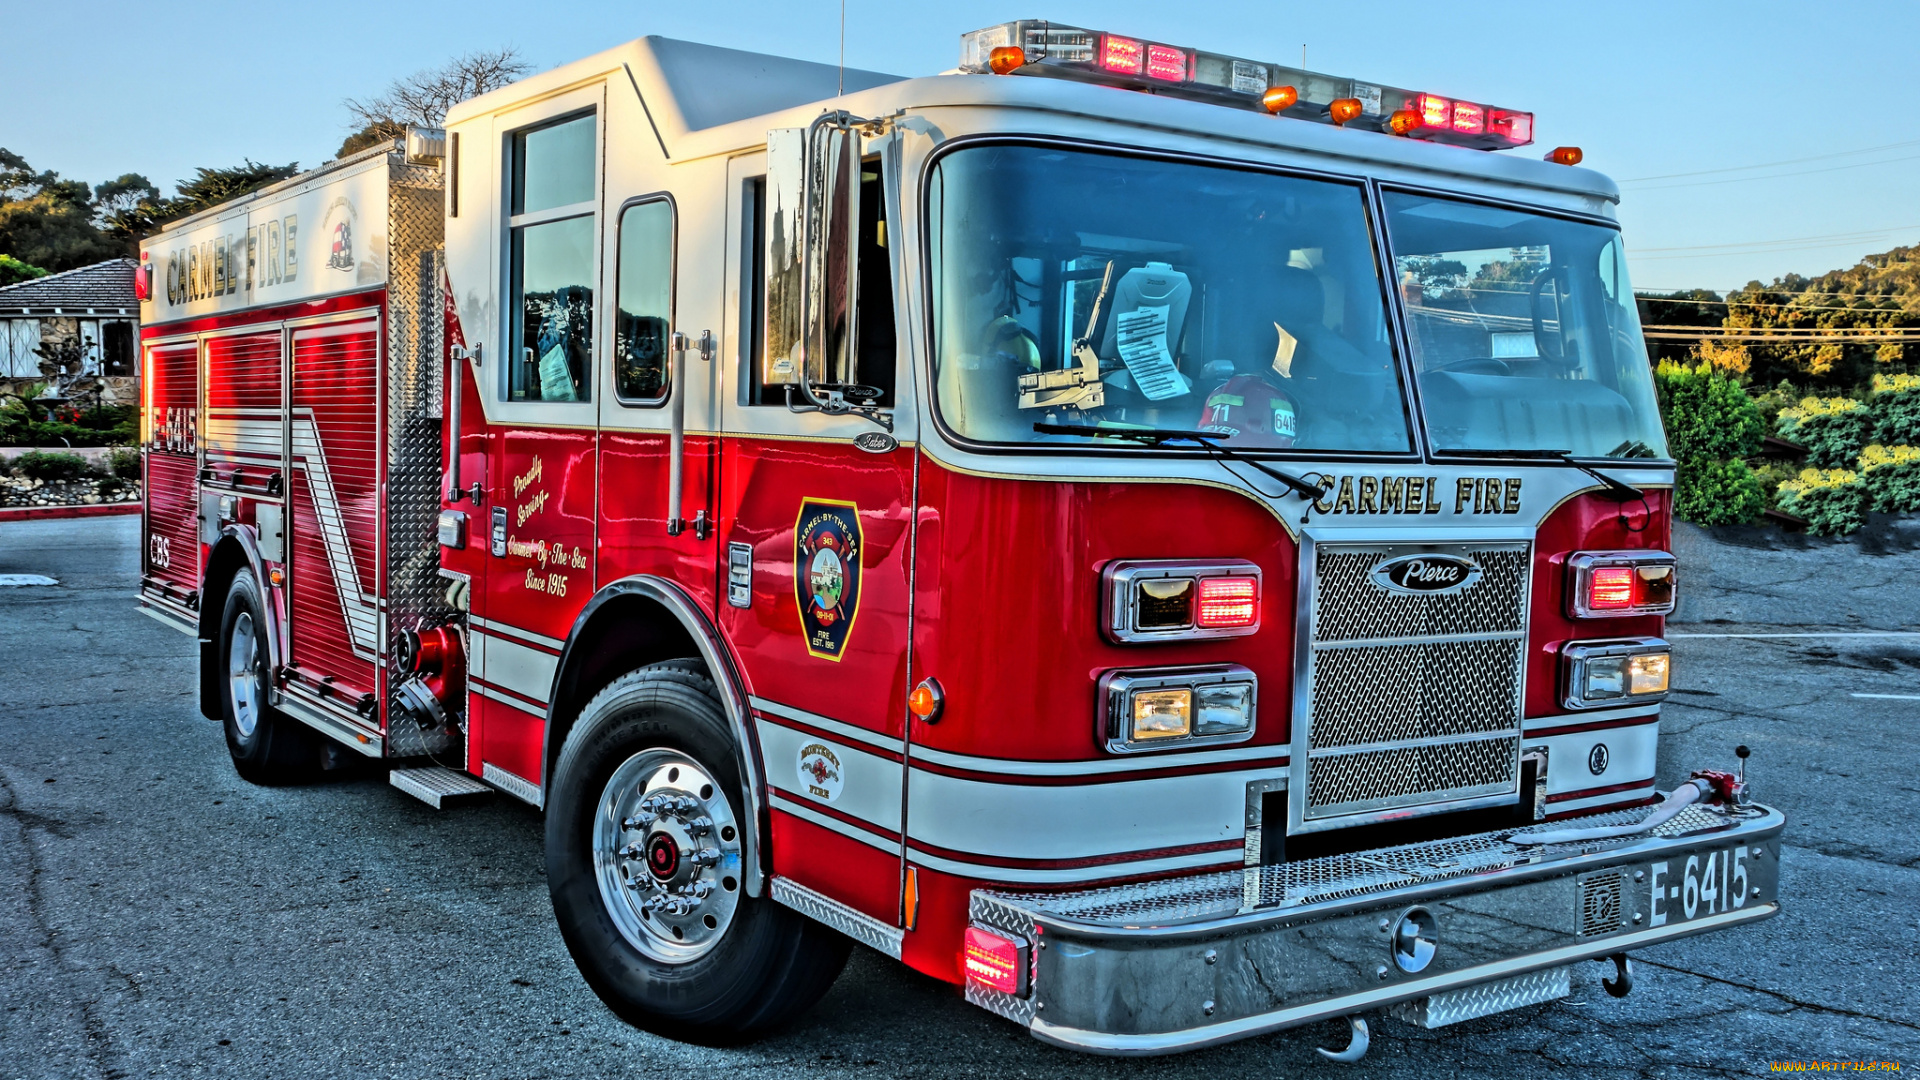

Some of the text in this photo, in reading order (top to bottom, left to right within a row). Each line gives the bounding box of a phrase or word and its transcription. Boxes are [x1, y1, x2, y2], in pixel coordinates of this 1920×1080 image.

[167, 233, 237, 307] CARMEL
[246, 213, 298, 291] FIRE
[514, 454, 543, 499] Proudly
[1313, 474, 1522, 515] CARMEL FIRE
[150, 533, 170, 568] CBS
[822, 537, 834, 546] 343
[525, 568, 568, 598] Since 1915
[1402, 560, 1459, 587] Pierce
[812, 637, 824, 648] EST.
[817, 630, 830, 640] FIRE
[809, 784, 830, 800] FIRE
[1650, 845, 1748, 928] E-6415
